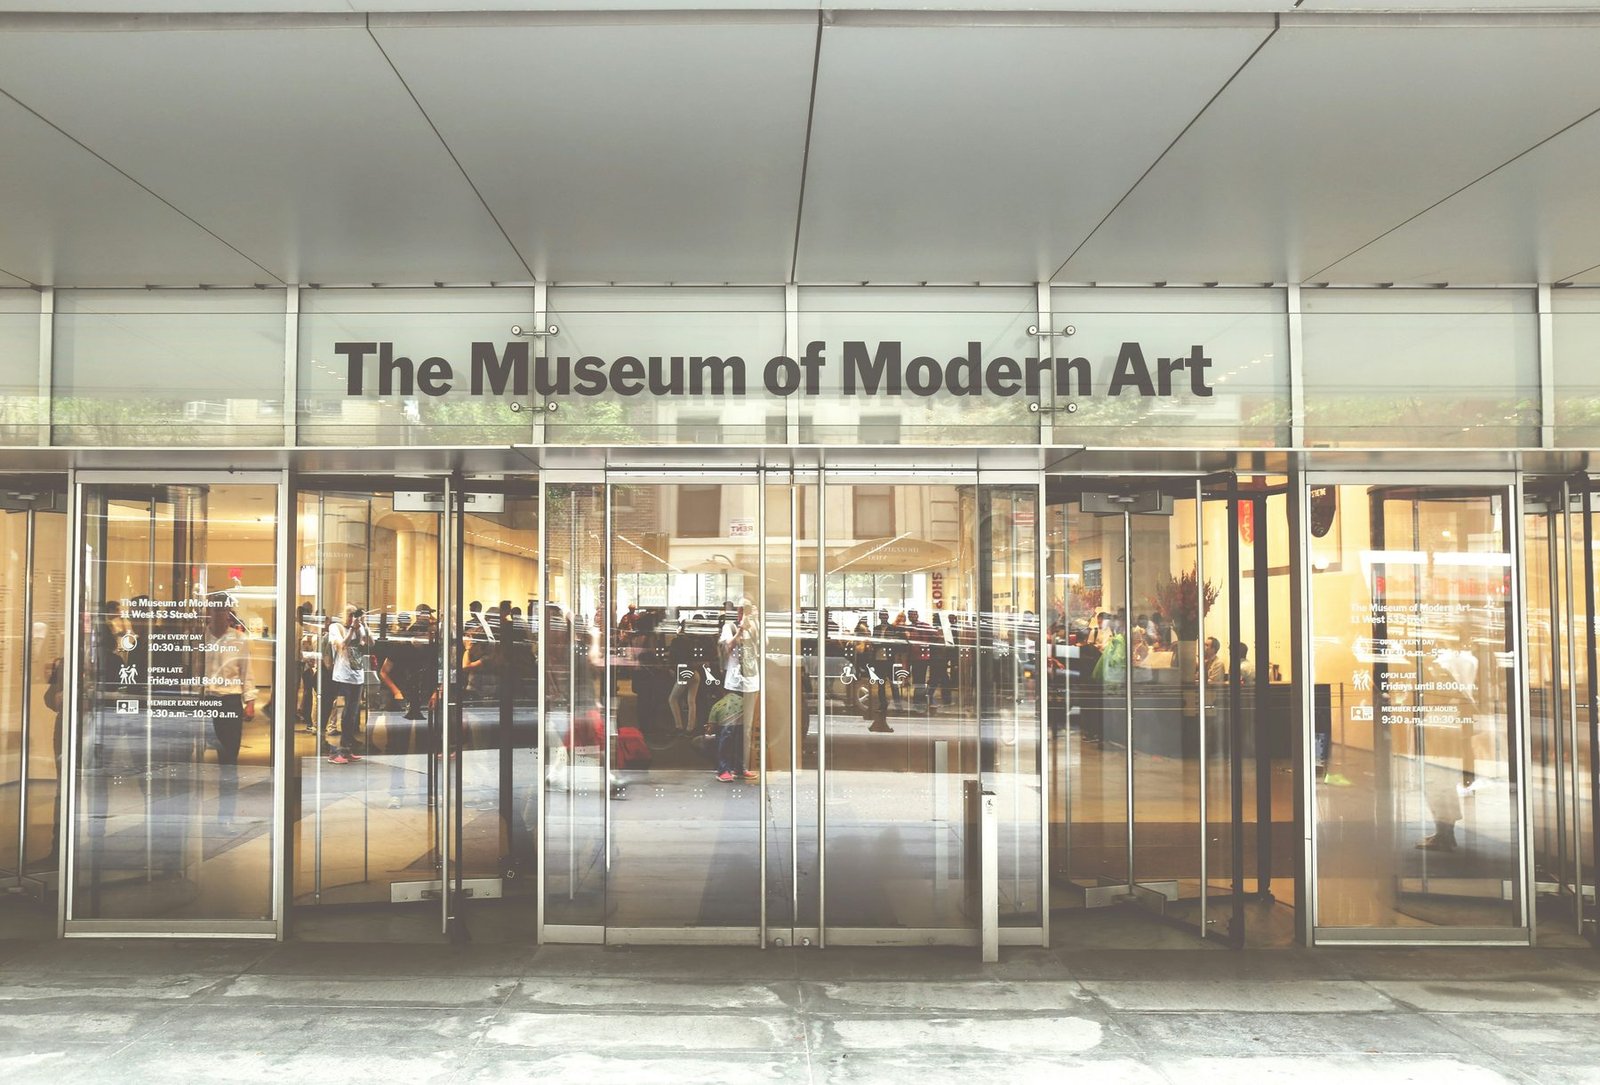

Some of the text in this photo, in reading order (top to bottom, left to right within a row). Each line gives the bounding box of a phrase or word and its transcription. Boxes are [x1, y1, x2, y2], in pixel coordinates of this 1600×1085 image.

[334, 340, 1213, 396] The Museum of Modern Art
[121, 599, 239, 608] The Museum of Modern Art
[1370, 603, 1407, 612] Museum
[1408, 603, 1418, 612] of
[1456, 603, 1471, 612] Art
[120, 610, 198, 619] 11 West 53 Street
[1362, 615, 1386, 624] West
[148, 643, 174, 652] 10:30
[220, 645, 240, 654] p.m.
[147, 676, 244, 687] Fridays until 8:00 p.m.
[1381, 681, 1413, 692] Fridays
[1414, 681, 1435, 691] until
[1436, 681, 1458, 691] 8:00
[147, 709, 168, 718] 9:30
[1381, 715, 1403, 724] 9:30
